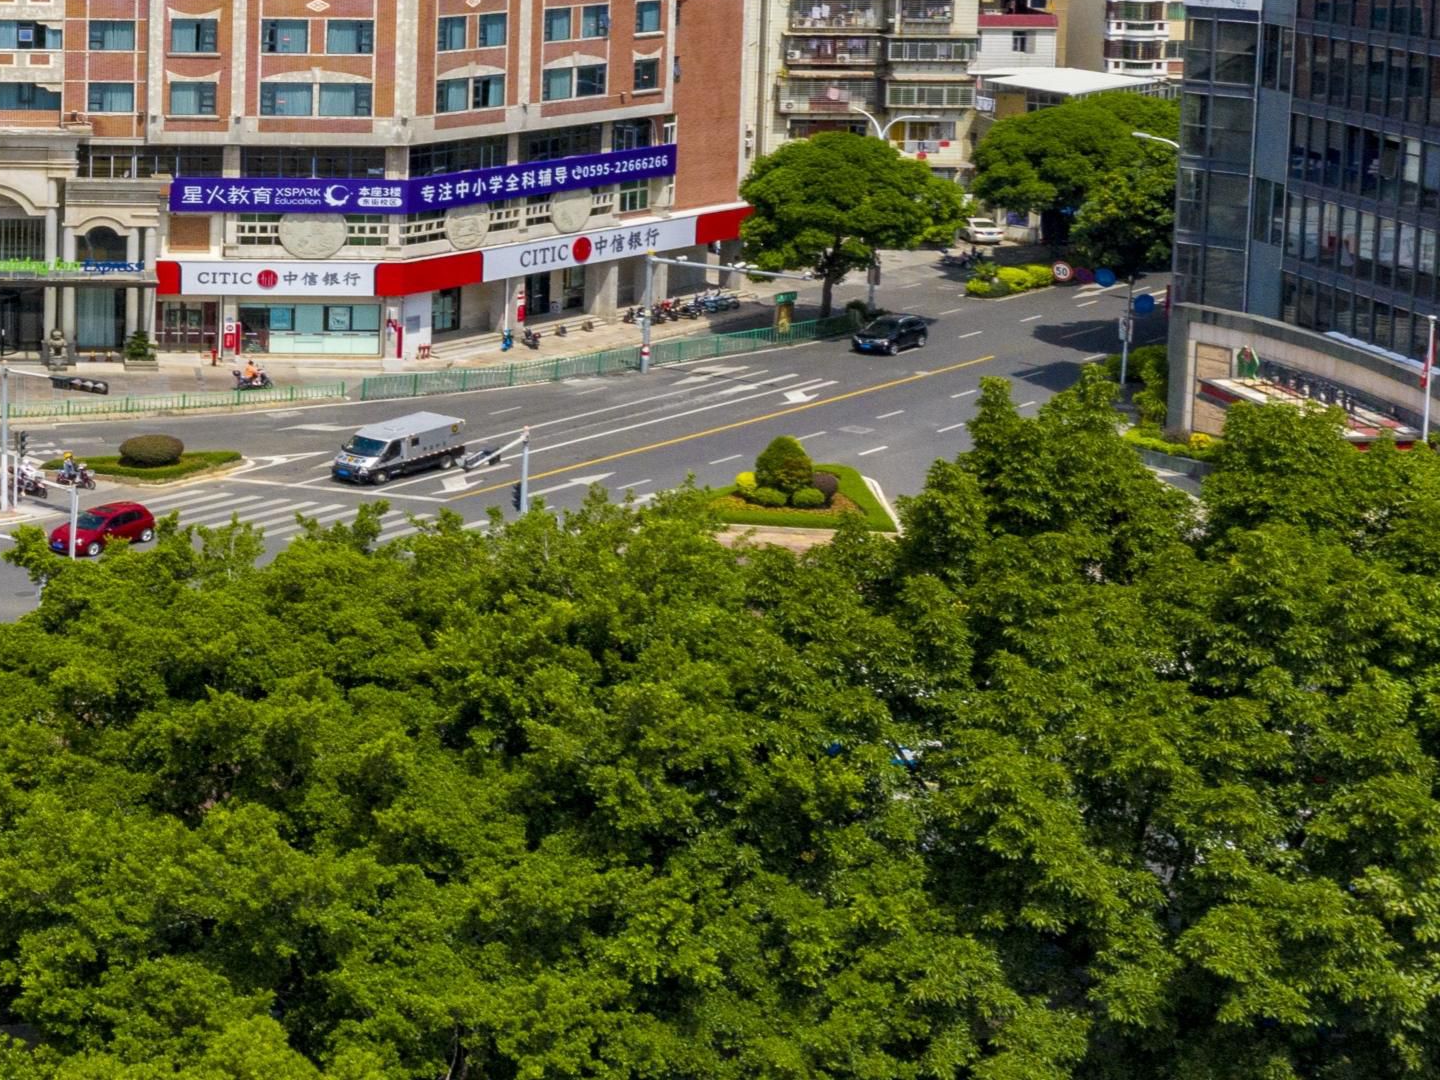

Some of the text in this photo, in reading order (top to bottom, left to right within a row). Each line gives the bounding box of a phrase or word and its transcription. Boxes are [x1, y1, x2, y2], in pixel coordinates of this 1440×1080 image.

[420, 154, 669, 204] 专注中小学全科辅导 0595-22666266
[181, 185, 273, 205] 星火教育
[275, 187, 321, 197] XSPARK
[358, 186, 401, 197] 本座3楼
[274, 197, 322, 206] Education
[520, 227, 660, 268] CITIC 中信银行
[83, 256, 145, 274] Express
[1056, 266, 1068, 277] 50
[197, 271, 361, 287] CITIC 中信银行
